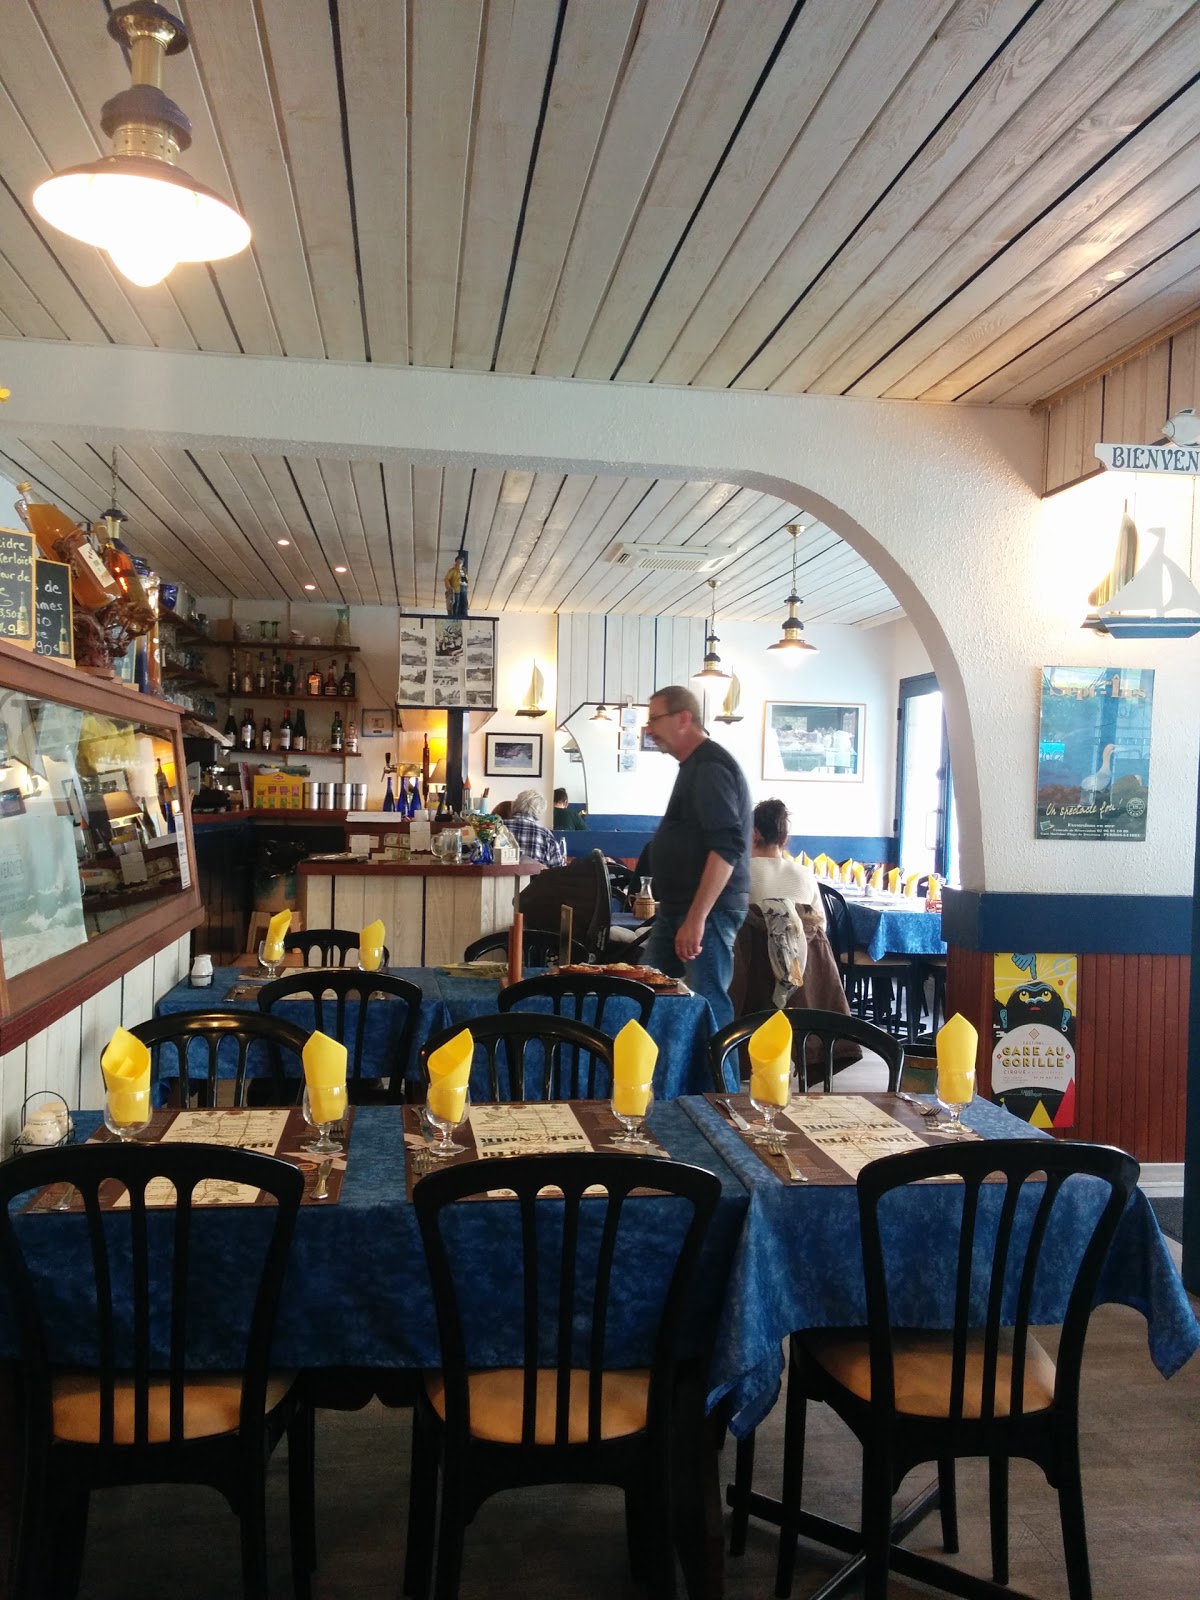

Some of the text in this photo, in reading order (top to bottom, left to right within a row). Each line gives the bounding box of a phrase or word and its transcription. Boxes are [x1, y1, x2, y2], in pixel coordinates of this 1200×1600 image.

[0, 537, 28, 551] idre
[44, 580, 62, 594] de
[1002, 1046, 1064, 1056] GARE AU
[1002, 1057, 1064, 1068] GORILLE
